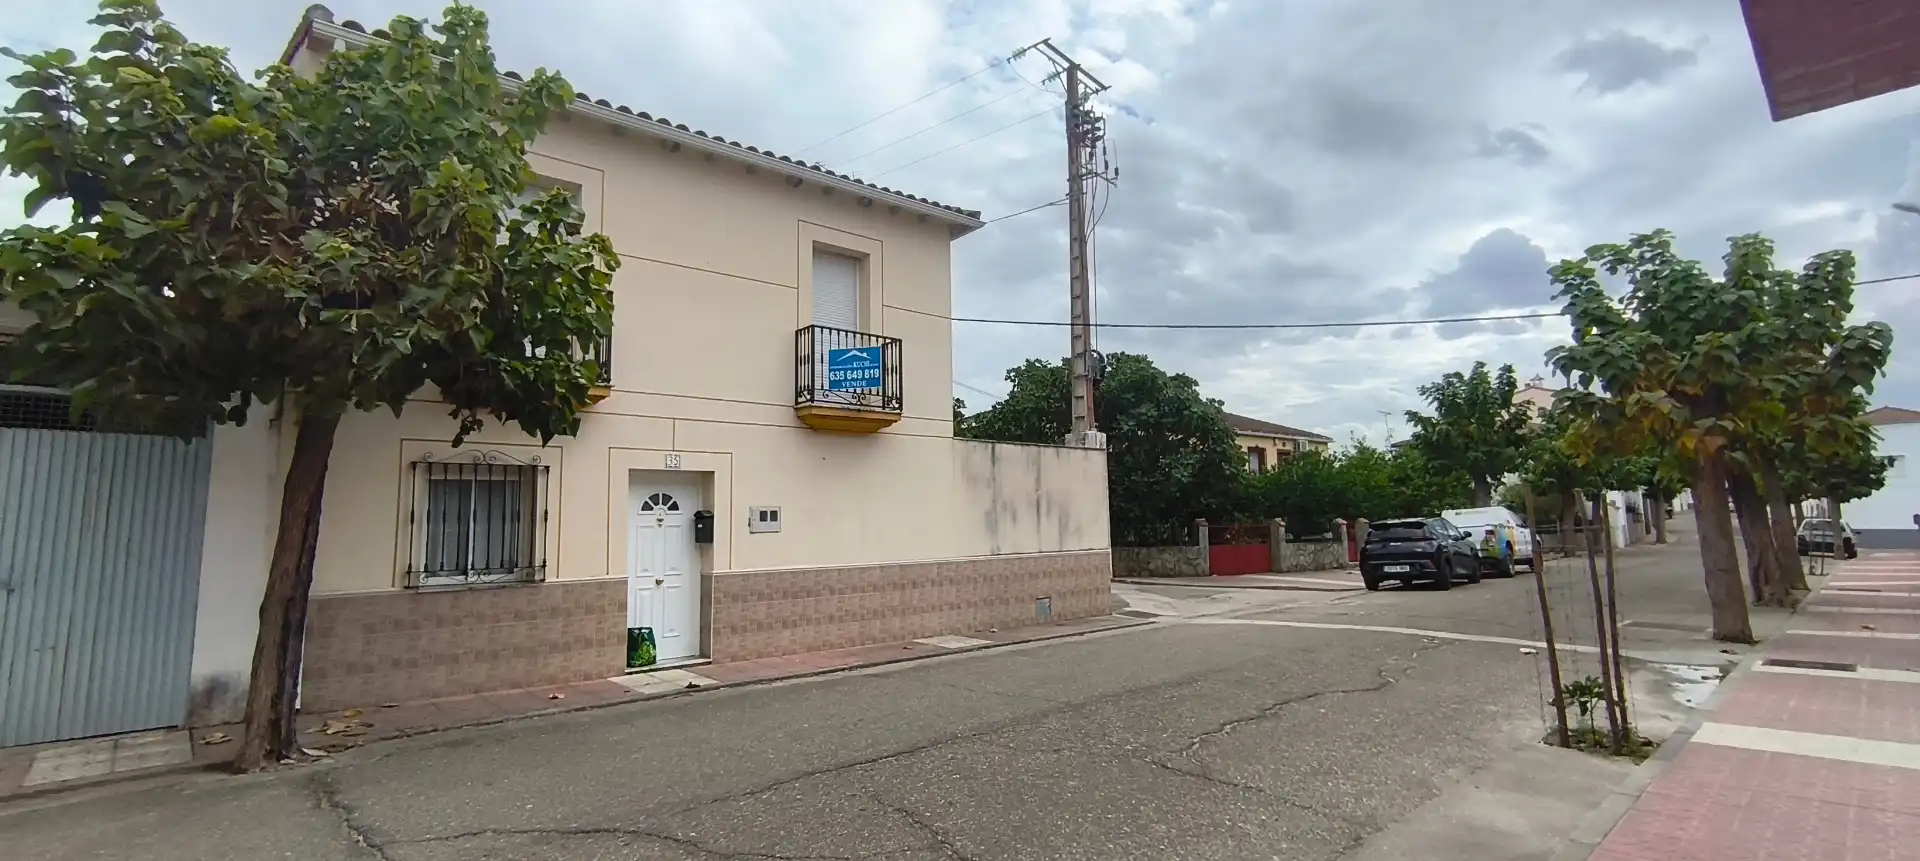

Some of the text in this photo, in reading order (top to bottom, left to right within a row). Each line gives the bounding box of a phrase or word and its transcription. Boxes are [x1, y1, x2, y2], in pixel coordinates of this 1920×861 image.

[830, 369, 880, 380] 635 649 819
